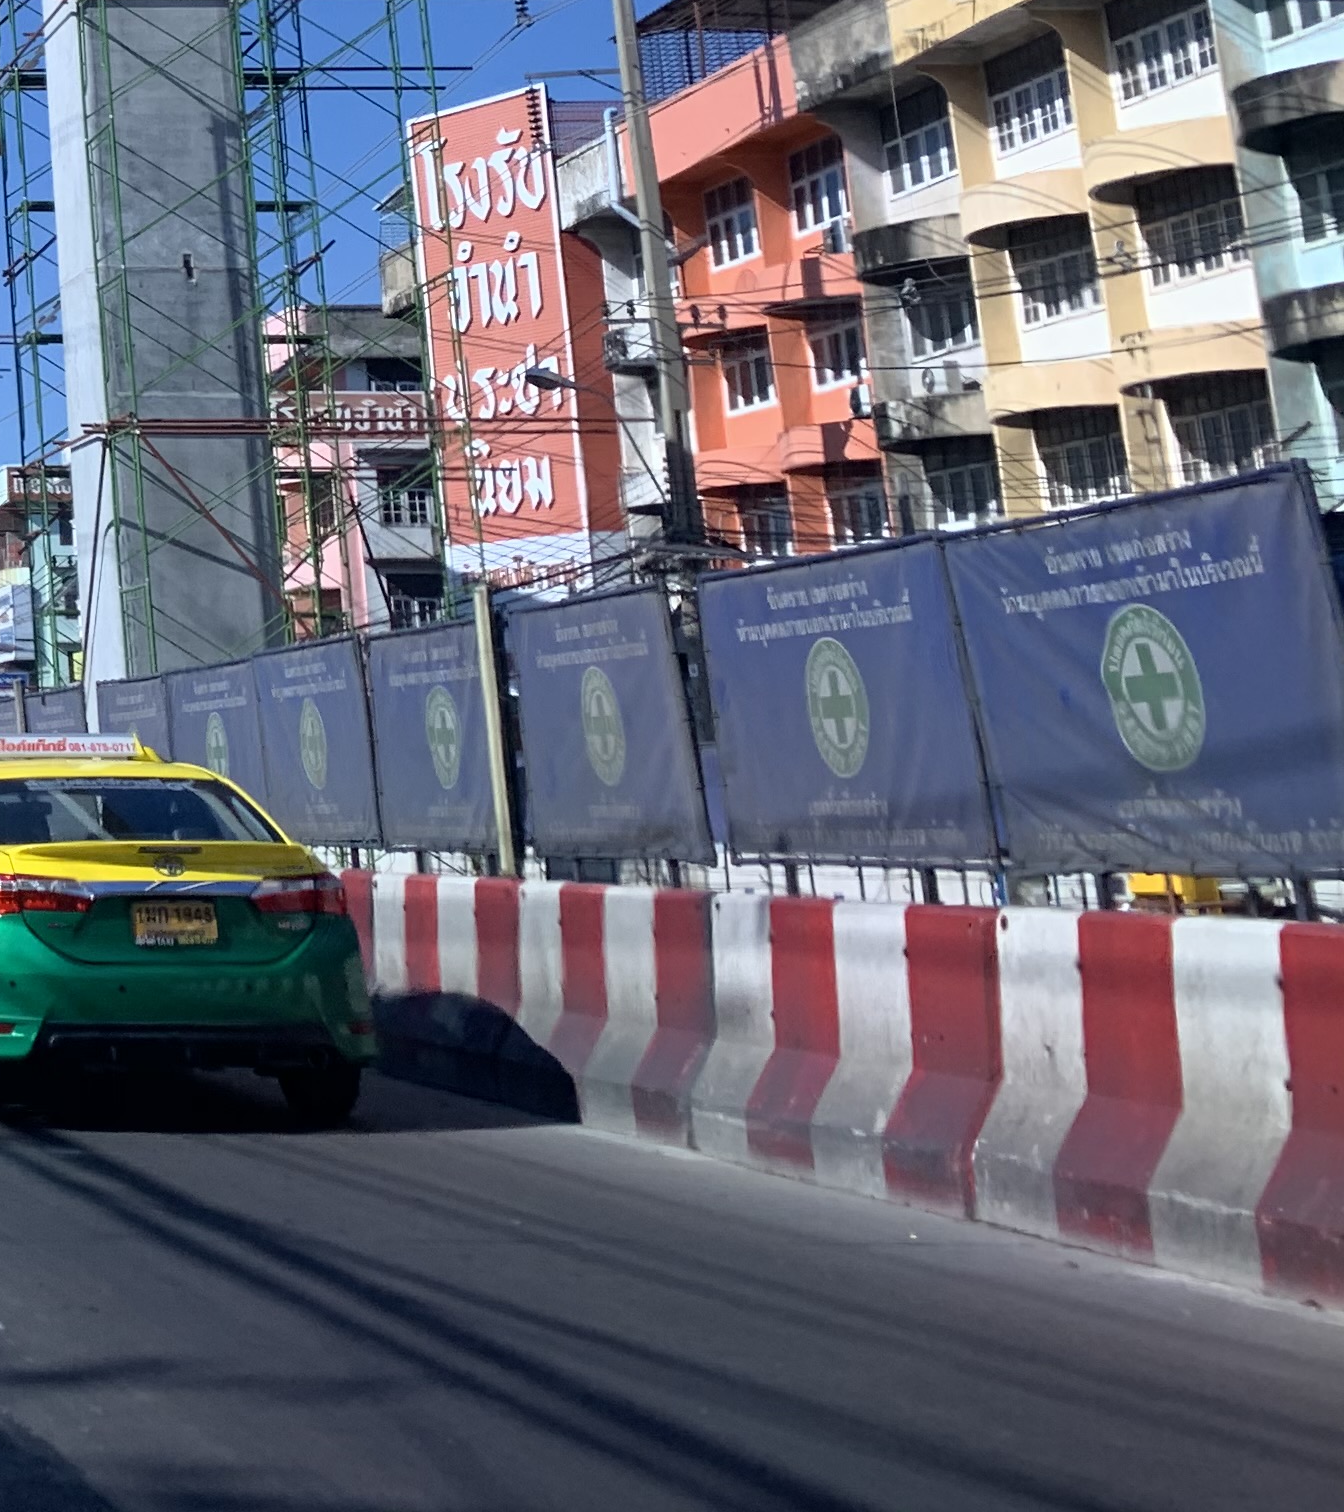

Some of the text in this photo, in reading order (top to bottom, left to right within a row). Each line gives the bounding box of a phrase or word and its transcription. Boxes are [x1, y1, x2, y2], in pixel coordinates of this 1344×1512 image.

[415, 127, 547, 231] โรงรับ
[448, 231, 543, 333] จำนำ
